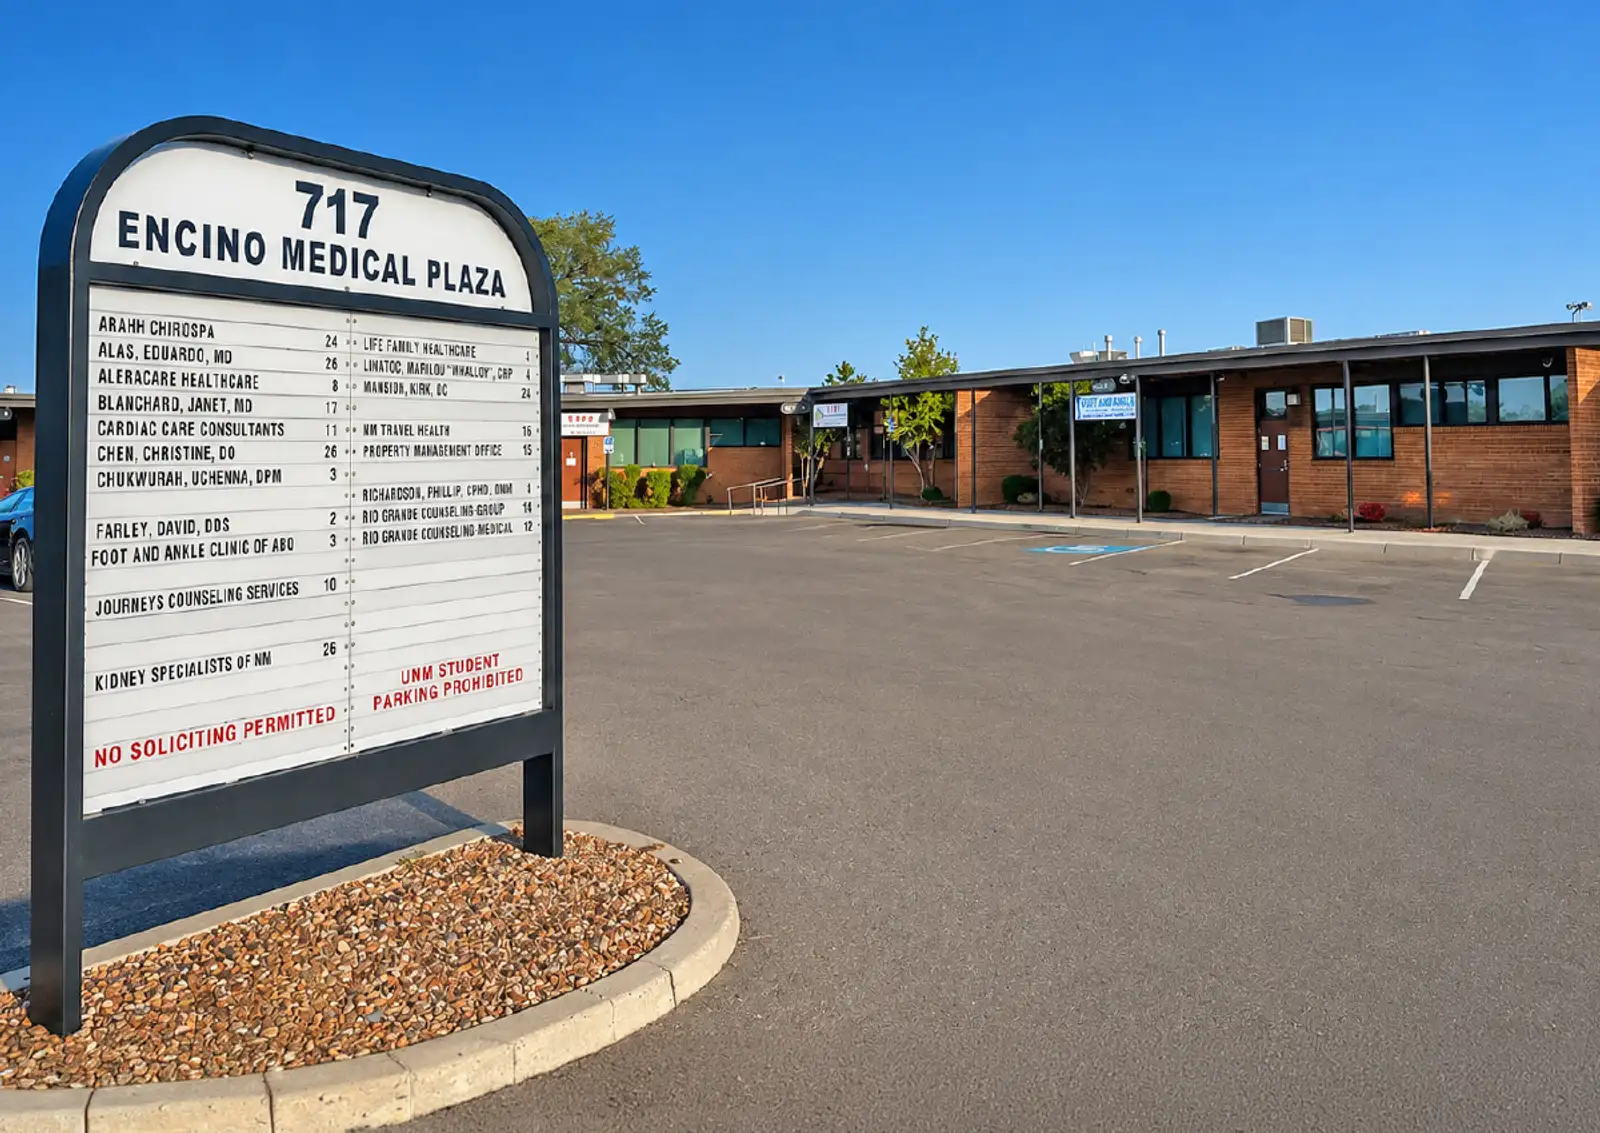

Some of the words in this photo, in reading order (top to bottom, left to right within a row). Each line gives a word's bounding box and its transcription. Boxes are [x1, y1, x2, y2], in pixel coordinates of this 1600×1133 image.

[295, 180, 379, 238] 717
[118, 211, 266, 265] ENCINO
[282, 236, 416, 286] MEDICAL
[427, 260, 506, 298] PLAZA
[150, 320, 215, 339] CHIROSPA
[325, 335, 338, 348] 24
[363, 337, 383, 351] LIFE
[386, 339, 420, 353] FAMILY
[423, 342, 476, 359] HEALTHCARE
[98, 342, 139, 361] ALAS,
[144, 344, 209, 366] EDUARDO,
[214, 351, 232, 364] MD
[325, 357, 338, 370] 26
[98, 368, 176, 387] ALERACARE
[181, 373, 259, 390] HEALTHCARE
[332, 380, 338, 392] 8
[521, 387, 531, 399] 24
[98, 394, 183, 414] BLANCHARD,
[187, 398, 231, 414] JANET,
[235, 398, 252, 413] MD
[326, 402, 337, 414] 17
[98, 420, 157, 437] CARDIAC
[162, 421, 195, 437] CARE
[200, 421, 285, 437] CONSULTANTS
[325, 424, 337, 436] 11
[381, 424, 414, 437] TRAVEL
[417, 425, 450, 436] HEALTH
[522, 426, 532, 437] 16
[98, 445, 138, 464] CHEN,
[143, 445, 215, 463] CHRISTINE,
[219, 445, 235, 460] DO
[324, 445, 337, 458] 26
[363, 445, 411, 457] PROPERTY
[413, 444, 471, 457] MANAGEMENT
[475, 444, 502, 456] OFFICE
[523, 444, 532, 456] 15
[97, 471, 188, 488] CHUKWURAH,
[192, 470, 253, 487] UCHENNA,
[256, 469, 282, 484] DPM
[330, 468, 337, 481] 3
[362, 487, 425, 502] RICHARDSON,
[523, 502, 532, 514] 14
[330, 512, 336, 525] 2
[362, 510, 379, 524] RIO
[382, 508, 418, 522] GRANDE
[97, 522, 152, 540] FARLEY,
[157, 519, 200, 537] DAVID,
[205, 518, 230, 533] DDS
[523, 520, 533, 532] 12
[330, 535, 336, 547] 3
[362, 531, 379, 545] RIO
[382, 528, 418, 543] GRANDE
[92, 549, 128, 567] FOOT
[133, 546, 160, 563] AND
[164, 543, 205, 561] ANKLE
[210, 540, 250, 557] CLINIC
[254, 538, 269, 553] OF
[323, 577, 336, 592] 10
[95, 595, 164, 617] JOURNEYS
[168, 586, 243, 609] COUNSELING
[247, 581, 299, 599] SERVICES
[323, 642, 336, 656] 26
[95, 670, 146, 691] KIDNEY
[151, 656, 232, 683] SPECIALISTS
[237, 654, 251, 669] OF
[255, 651, 271, 666] NM
[401, 665, 433, 685] UNM
[439, 653, 499, 677] STUDENT
[373, 685, 438, 711] PARKING
[444, 668, 523, 696] PROHIBITED
[95, 746, 121, 768] NO
[130, 724, 236, 760] SOLICITING
[244, 706, 336, 739] PERMITTED
